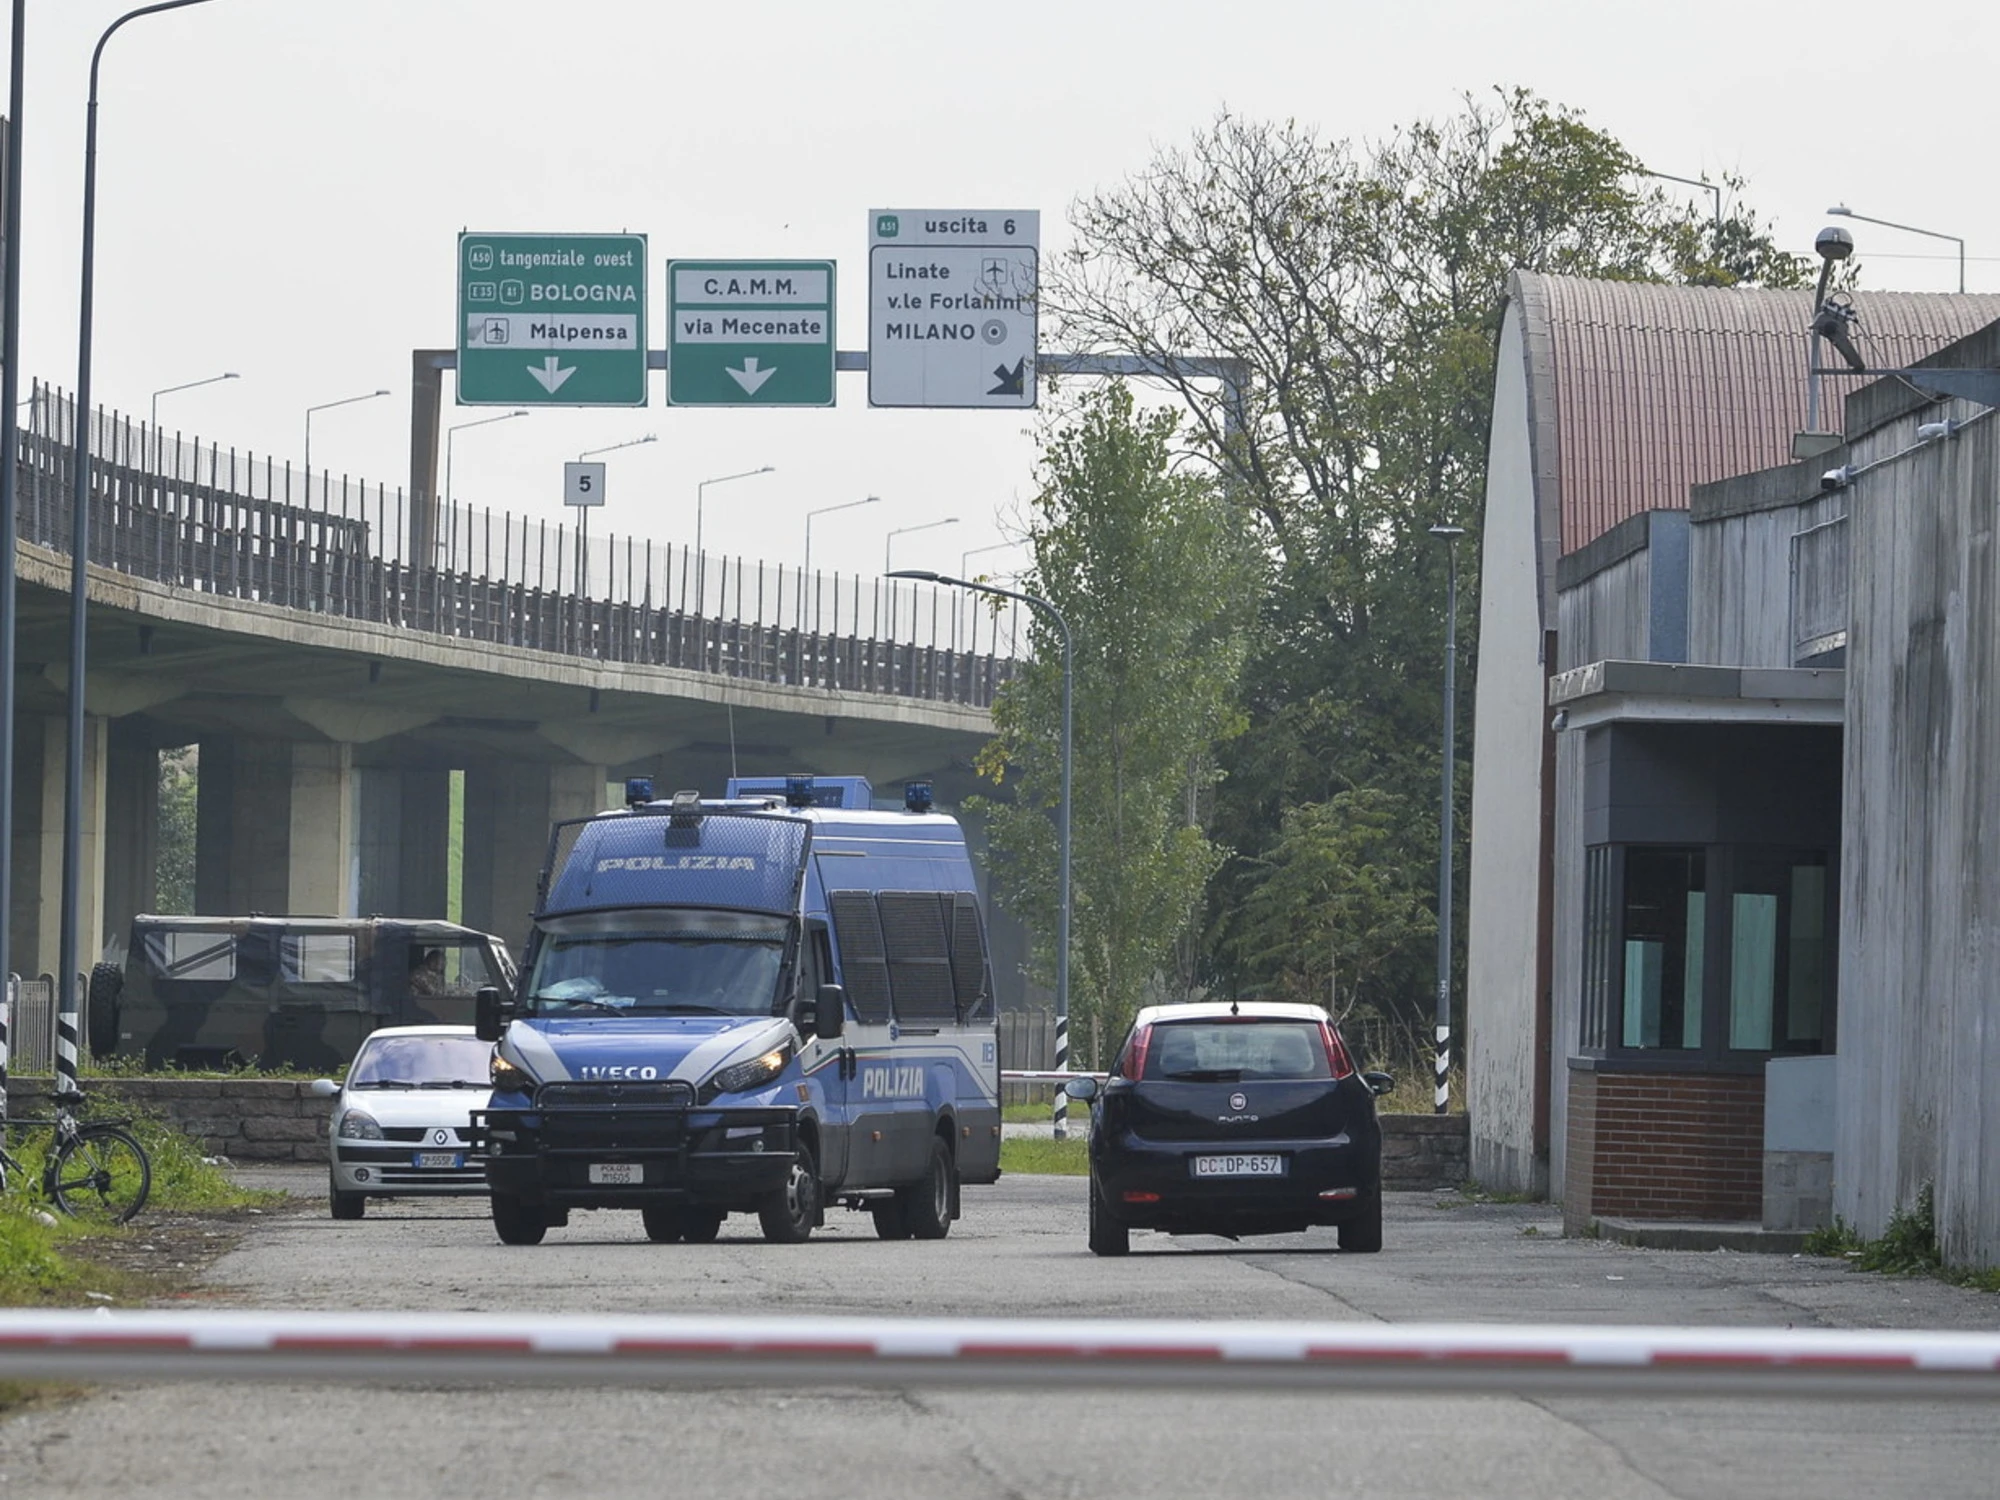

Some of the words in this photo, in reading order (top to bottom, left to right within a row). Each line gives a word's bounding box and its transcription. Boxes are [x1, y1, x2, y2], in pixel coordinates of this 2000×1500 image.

[880, 221, 896, 232] A51
[925, 218, 988, 234] uscita
[1004, 219, 1016, 235] 6
[472, 252, 490, 264] A50
[500, 250, 585, 270] tangenziale
[594, 251, 633, 267] ovest
[887, 263, 950, 279] Linate
[506, 287, 517, 297] A1
[531, 284, 637, 301] BOLOGNA
[888, 294, 922, 309] v.le
[930, 293, 1022, 310] Forlanini
[530, 323, 628, 342] Malpensa
[684, 318, 713, 335] via
[722, 318, 821, 335] Mecenate
[886, 323, 976, 340] MILANO
[579, 475, 592, 493] 5
[597, 856, 755, 872] POLIZIA
[581, 1066, 658, 1080] IVECO
[863, 1067, 925, 1097] POLIZIA
[1199, 1158, 1217, 1173] CC
